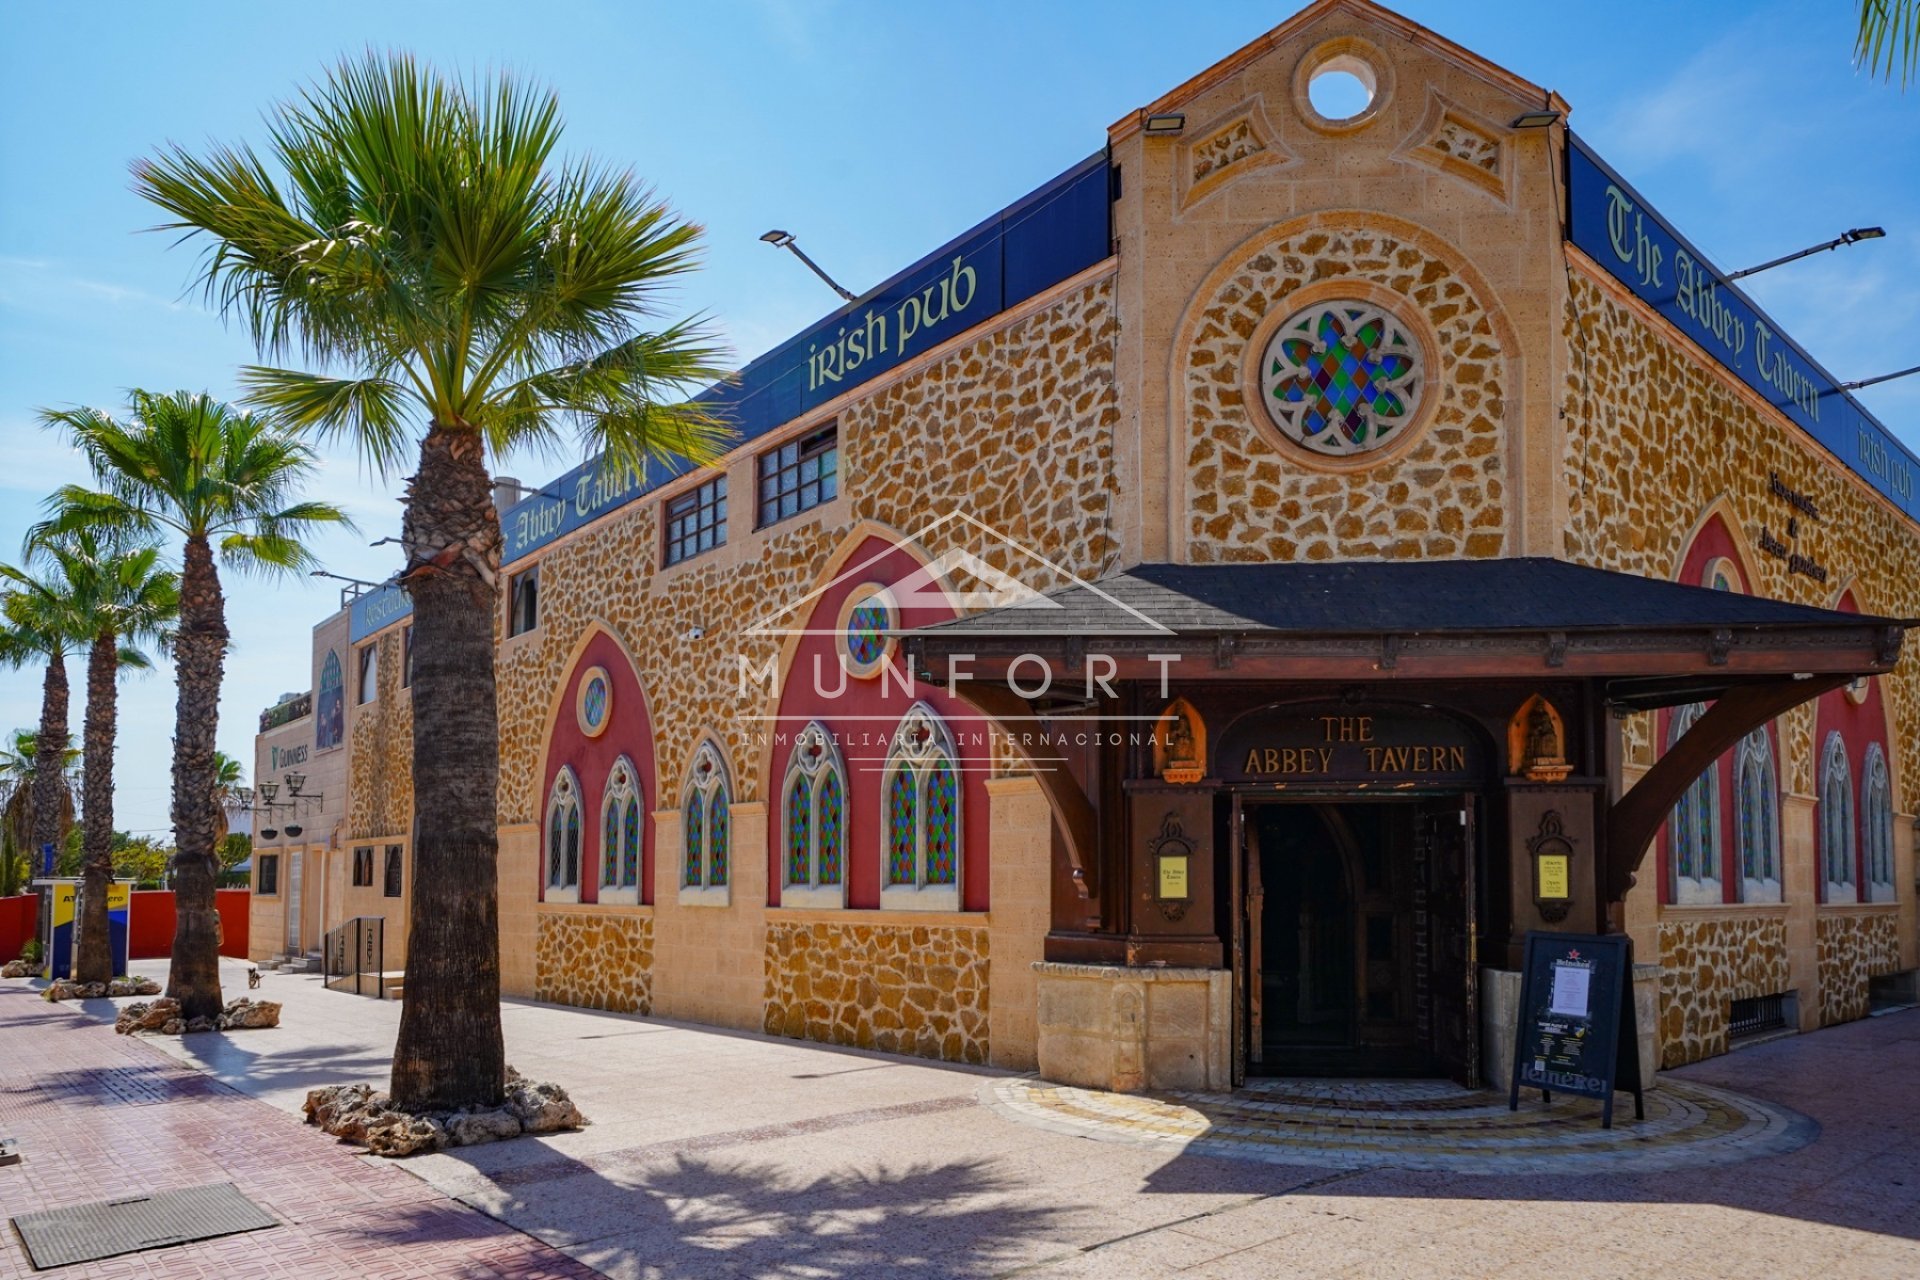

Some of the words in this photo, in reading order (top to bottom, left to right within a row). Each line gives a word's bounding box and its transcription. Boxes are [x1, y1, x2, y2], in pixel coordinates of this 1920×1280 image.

[897, 255, 977, 357] pub
[1606, 184, 1663, 289] The
[1675, 249, 1746, 369] Abbey
[1755, 320, 1820, 423] Tavern
[1889, 461, 1913, 501] pub
[516, 498, 567, 550] Abbey
[1319, 716, 1375, 743] THE
[1244, 748, 1334, 774] ABBEY
[1362, 746, 1466, 772] TAVERN
